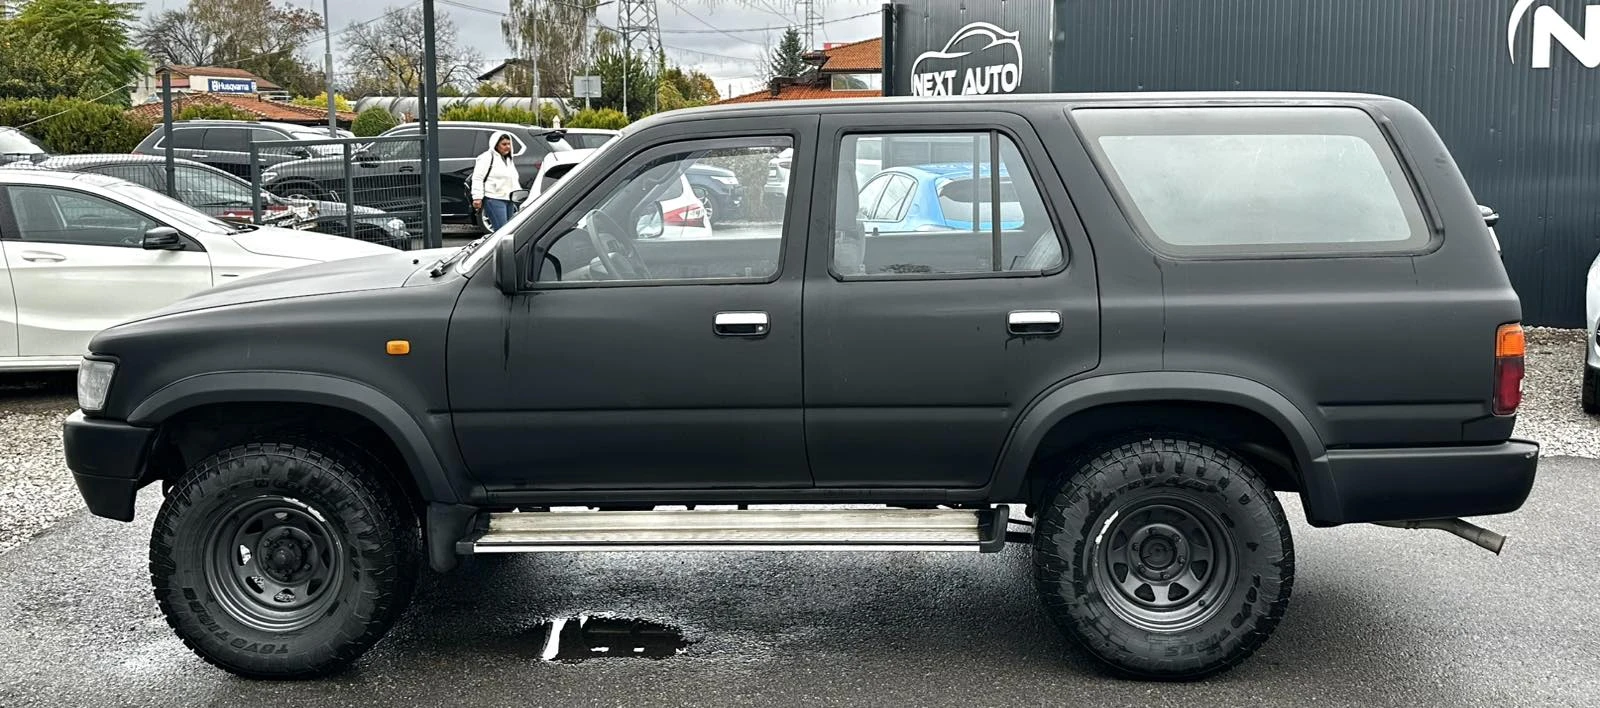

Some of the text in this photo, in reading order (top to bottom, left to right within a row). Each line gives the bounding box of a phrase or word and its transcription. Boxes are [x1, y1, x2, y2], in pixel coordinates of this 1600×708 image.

[218, 81, 250, 91] Husqvarna
[913, 63, 1018, 96] NEXT AUTO
[230, 637, 289, 654] TOYO
